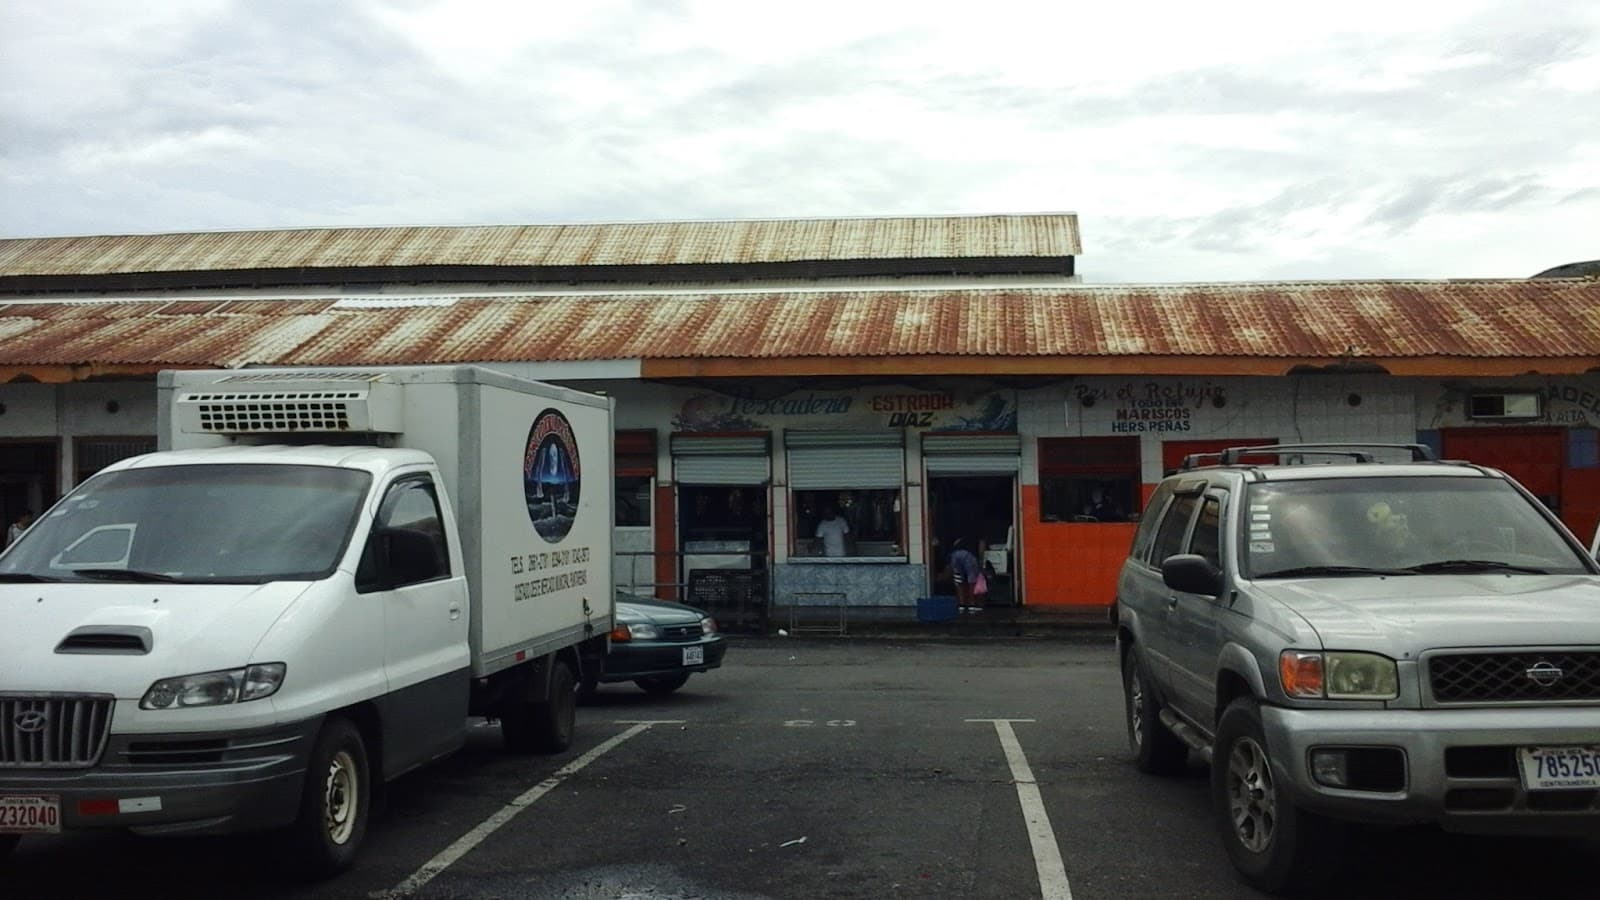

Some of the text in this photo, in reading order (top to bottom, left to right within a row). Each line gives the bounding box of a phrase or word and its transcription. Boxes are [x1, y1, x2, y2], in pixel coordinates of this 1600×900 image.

[872, 393, 954, 411] ESTRADA
[888, 412, 934, 427] DIAZ
[1116, 408, 1190, 420] MARISCOS
[0, 806, 56, 826] 232040
